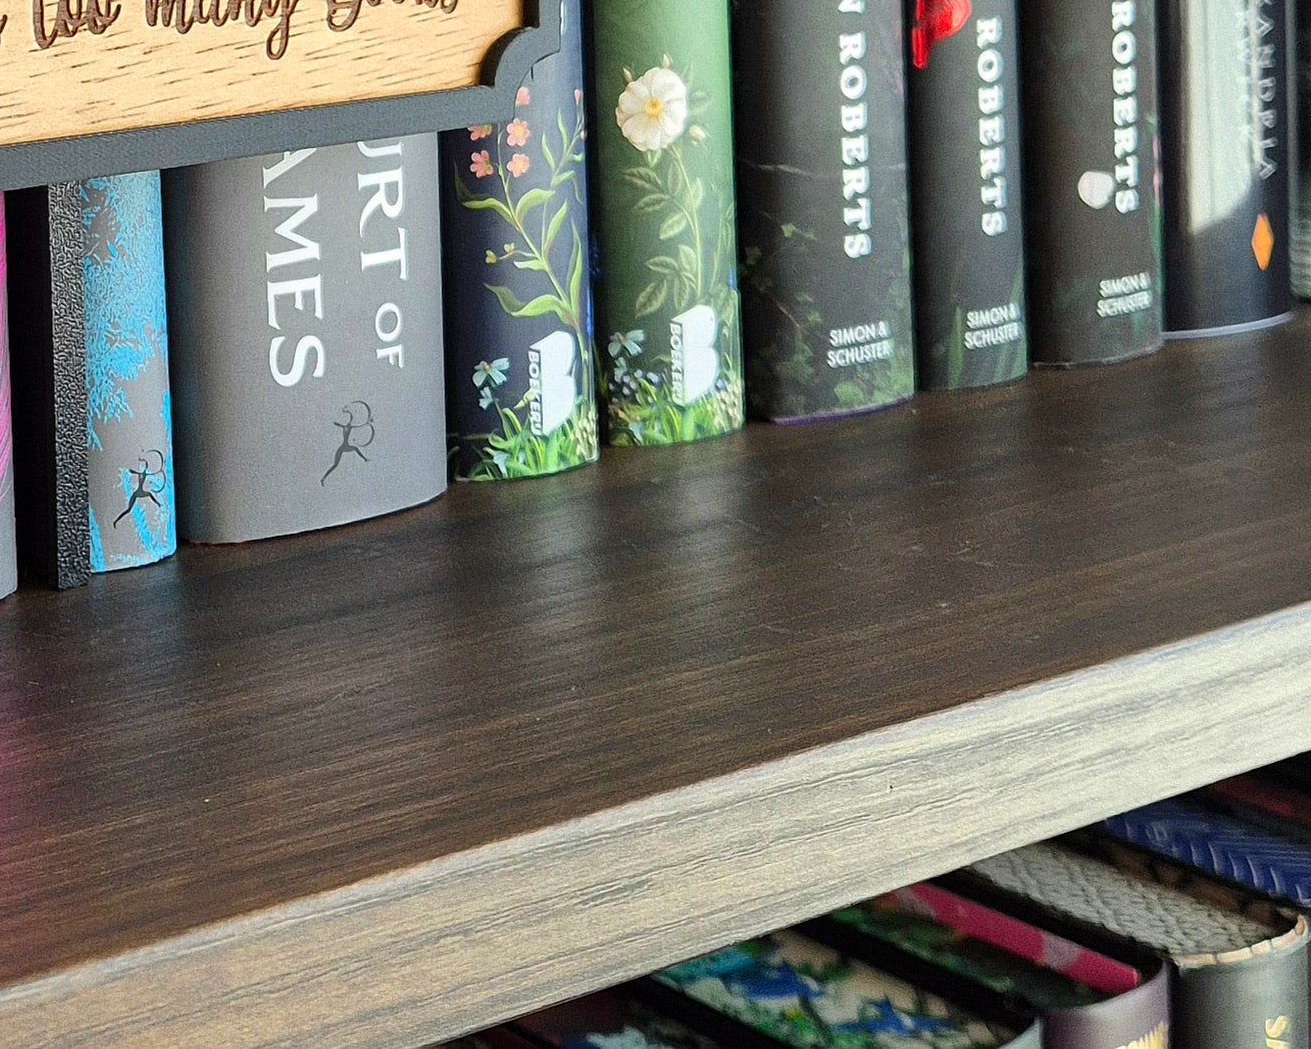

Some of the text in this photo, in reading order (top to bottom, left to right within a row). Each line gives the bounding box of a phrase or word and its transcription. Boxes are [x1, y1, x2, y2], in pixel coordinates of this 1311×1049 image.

[975, 17, 1007, 237] ROBERTS
[1112, 0, 1141, 216] ROBERTS
[839, 32, 872, 260] ROBERTS
[262, 147, 326, 389] AMES
[375, 303, 405, 369] OF
[829, 322, 876, 348] SIMON
[964, 321, 1024, 351] SCHUSTER
[966, 304, 1008, 330] SIMON
[827, 339, 896, 369] SCHUSTER
